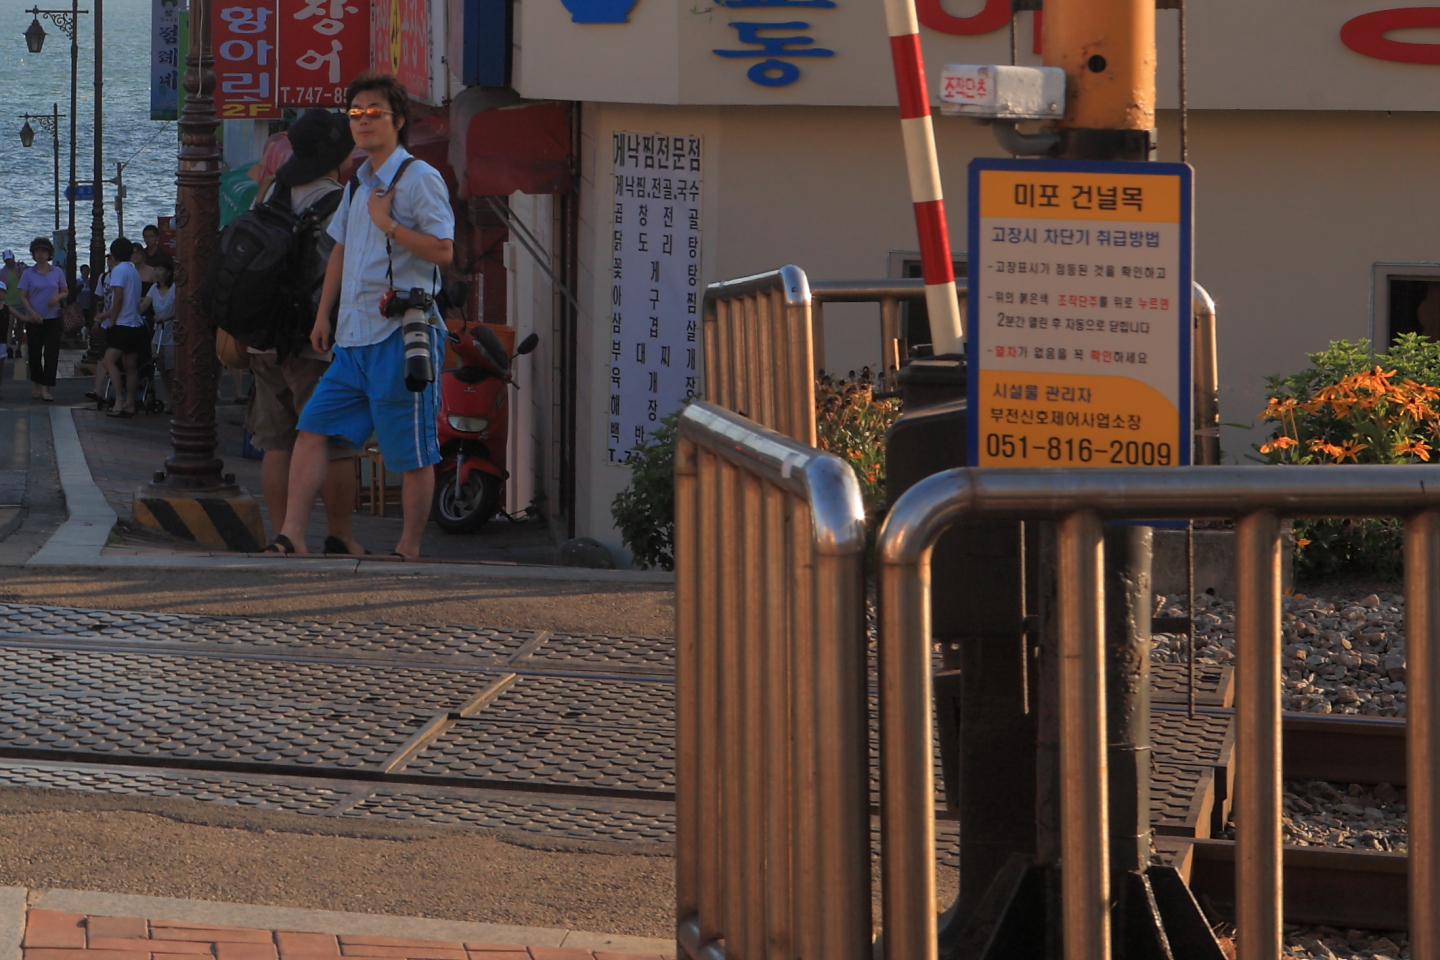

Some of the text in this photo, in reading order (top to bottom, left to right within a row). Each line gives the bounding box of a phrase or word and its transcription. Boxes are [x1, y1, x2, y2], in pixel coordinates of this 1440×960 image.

[219, 6, 273, 102] 항아리
[222, 103, 273, 117] 2F
[613, 134, 701, 172] 게낙찜전문점
[1014, 183, 1143, 212] 미포 건널목
[991, 227, 1160, 249] 고장시 차단기 취급방법
[1095, 265, 1114, 277] 것을
[1122, 266, 1166, 279] 확인하고
[1020, 292, 1048, 305] 붉은색
[1058, 294, 1107, 308] 조작단추를
[1114, 296, 1133, 309] 위로
[1138, 297, 1169, 311] 누르면
[1028, 317, 1048, 329] 열린
[1051, 318, 1061, 330] 후
[1065, 318, 1106, 332] 자동으로
[1034, 347, 1067, 360] 없음을
[1090, 350, 1148, 364] 확인하세요
[993, 383, 1093, 404] 시설물 관리자
[986, 433, 1172, 468] 051-816-2009
